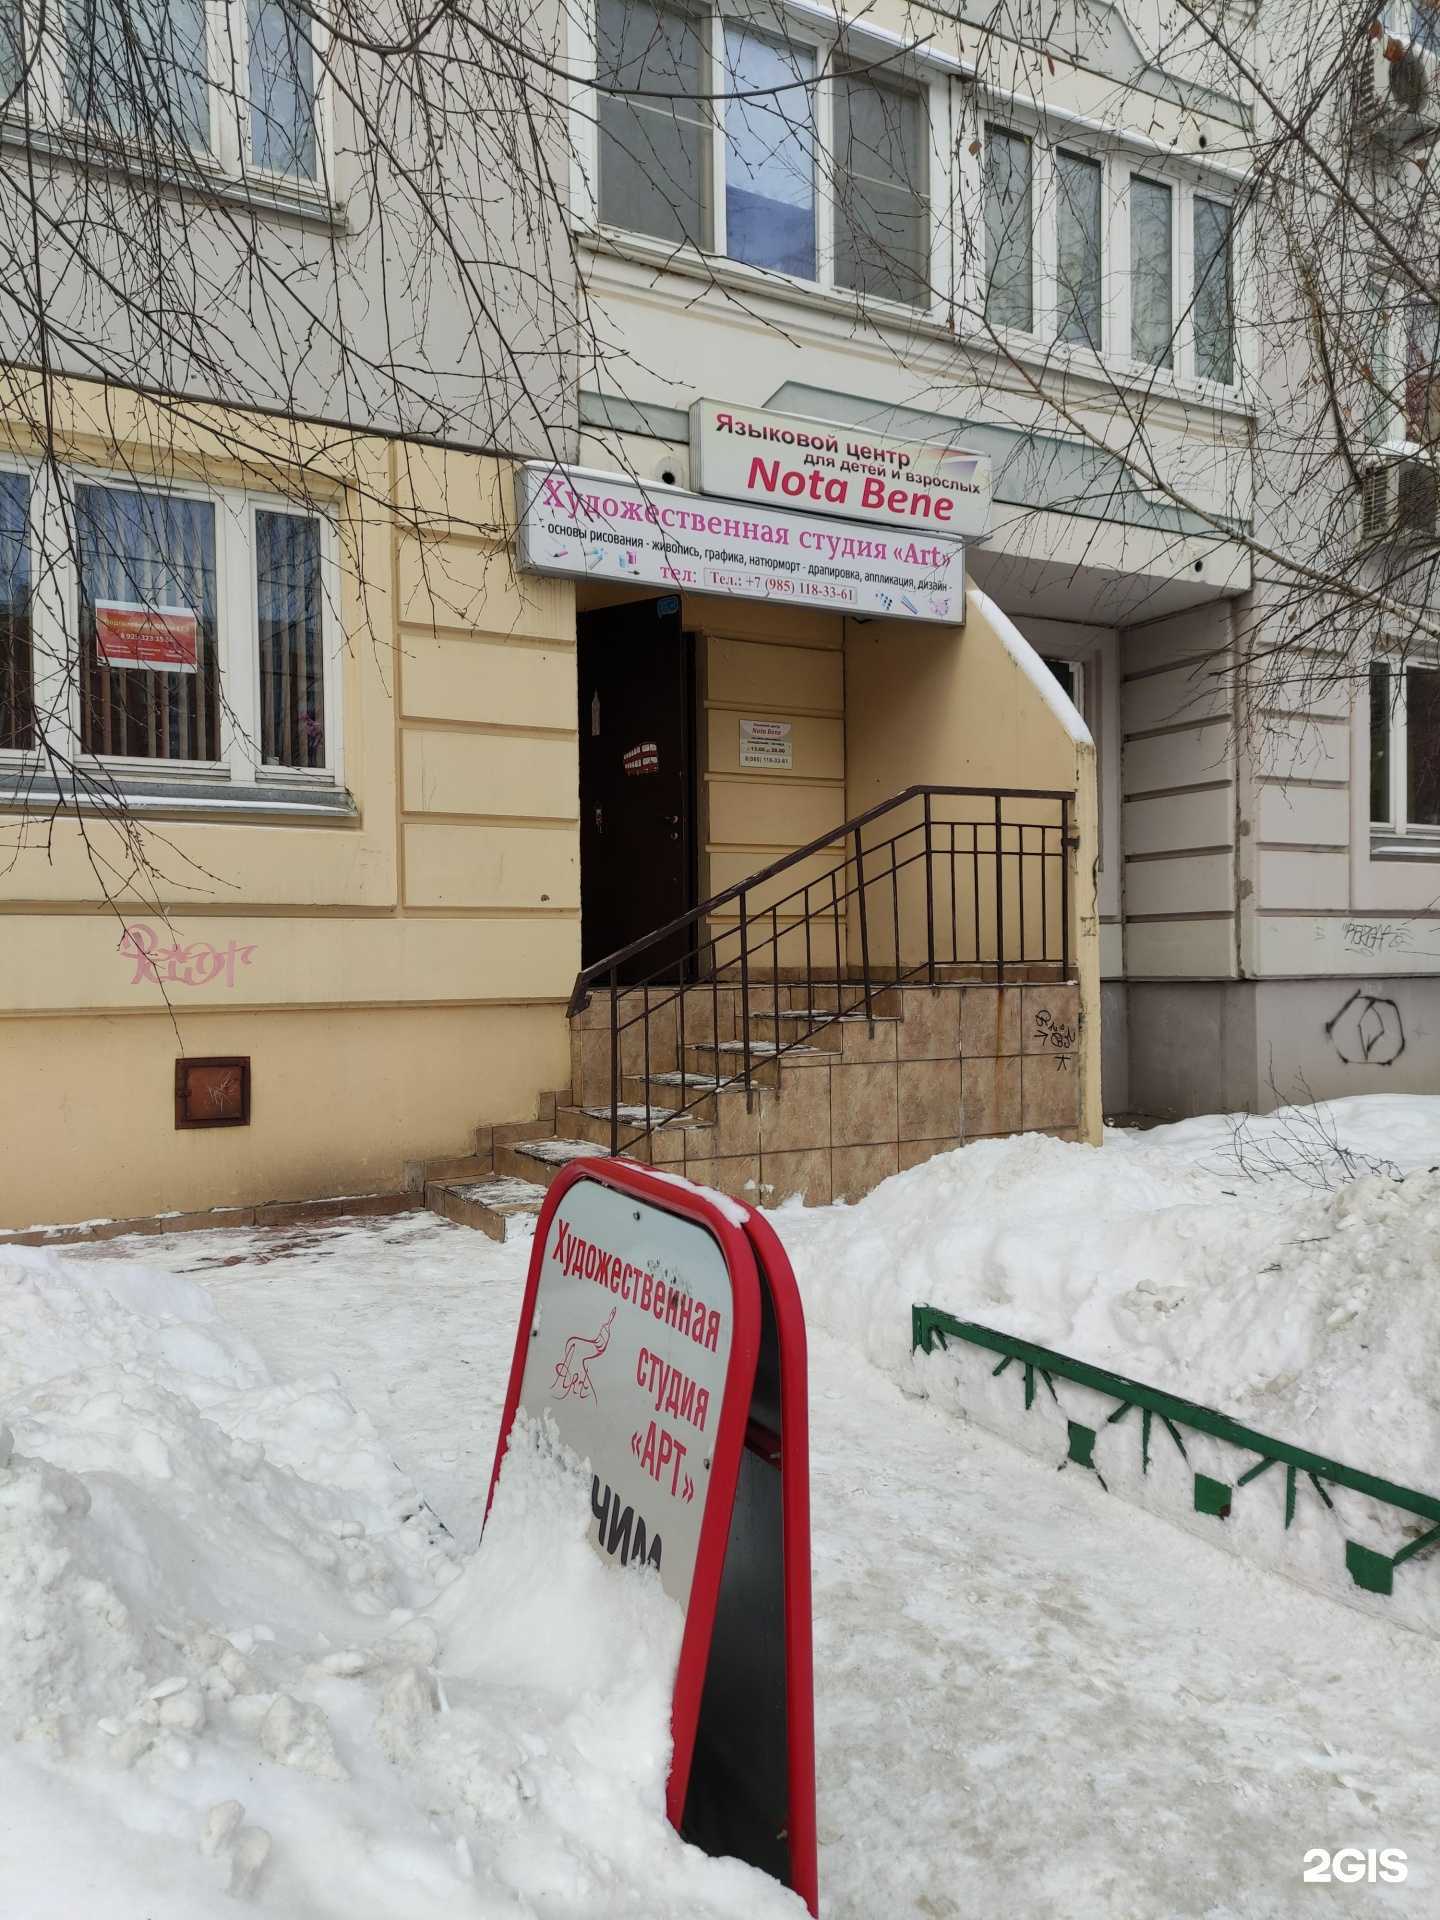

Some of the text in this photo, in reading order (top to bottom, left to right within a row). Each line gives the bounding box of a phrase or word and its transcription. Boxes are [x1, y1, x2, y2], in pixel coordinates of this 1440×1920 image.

[716, 413, 910, 469] Языковой центр
[804, 453, 980, 494] для детей и взрослых
[543, 478, 950, 568] Художественная студия «Art»
[747, 457, 954, 521] Nota Bene
[548, 523, 587, 539] основы
[590, 530, 644, 548] рисования
[652, 540, 702, 560] живопись,
[705, 549, 747, 566] графика,
[749, 555, 800, 573] натюрморт
[808, 564, 862, 582] драпировка,
[864, 573, 916, 590] аппликация,
[917, 579, 947, 592] дизайн
[660, 566, 854, 601] тел: Тел.: +7 (985) 118-33-61
[552, 1219, 721, 1352] Художественная
[636, 1347, 710, 1432] студия
[631, 1420, 694, 1504] «АРТ»
